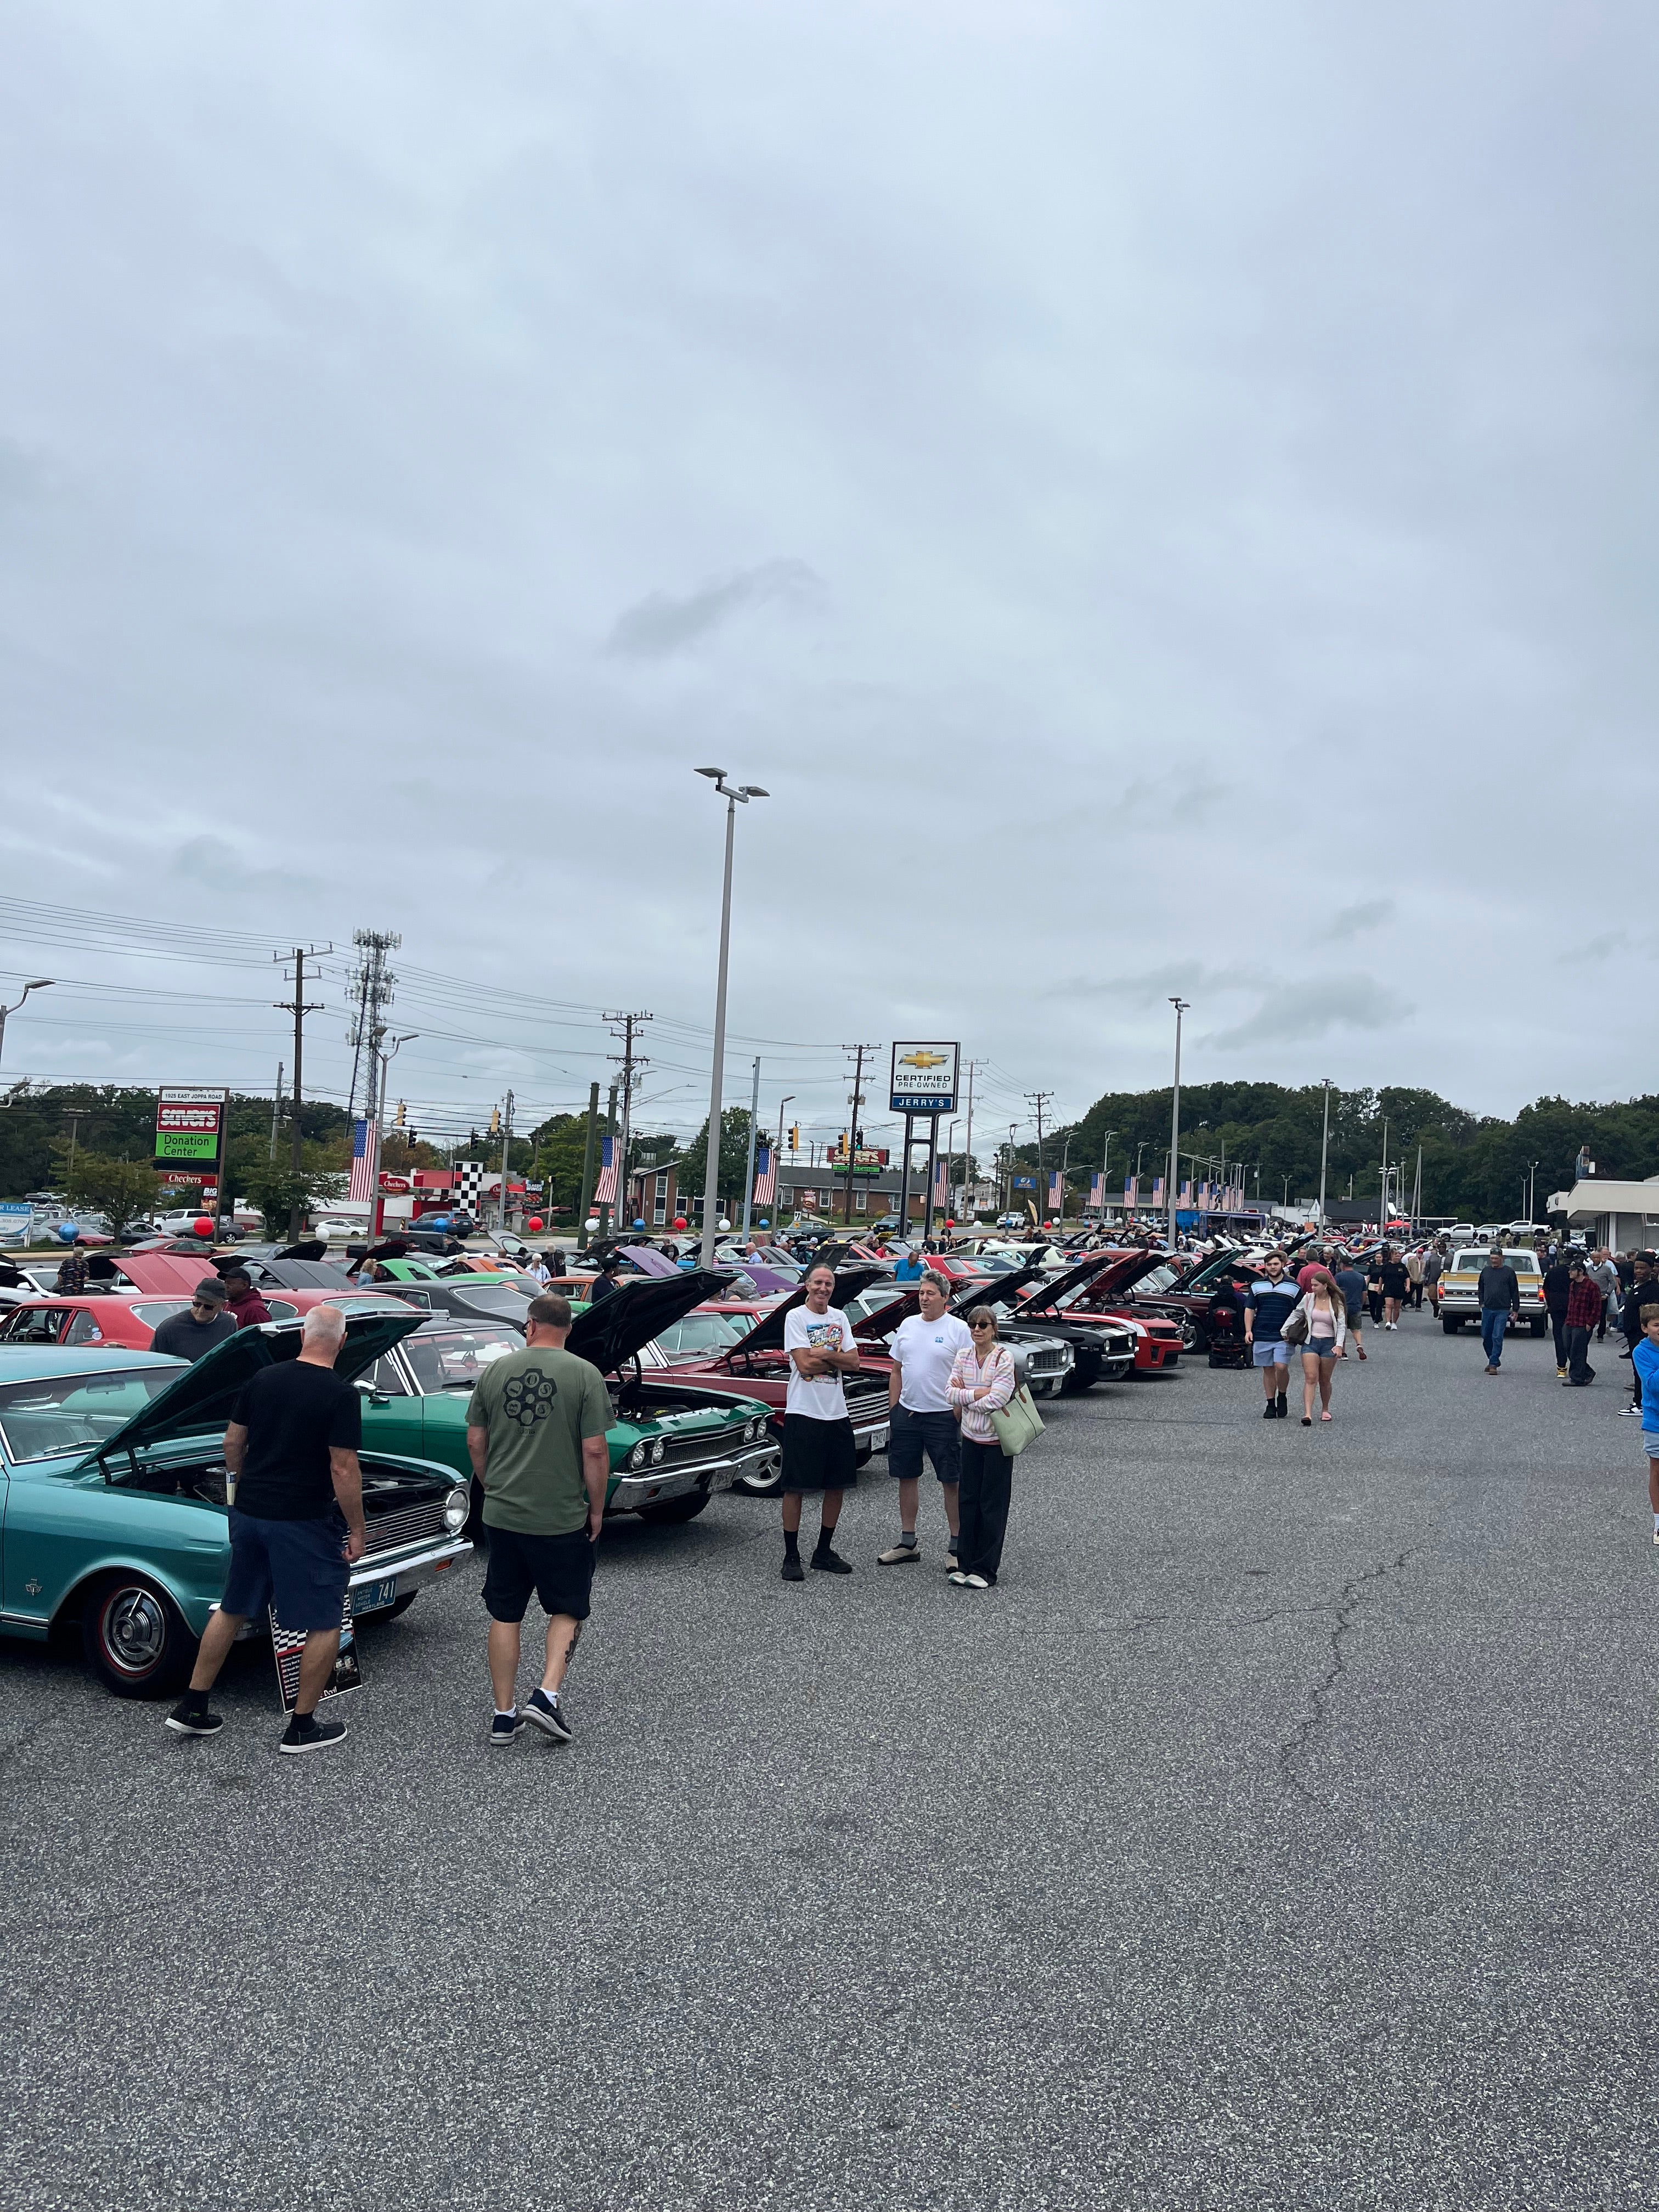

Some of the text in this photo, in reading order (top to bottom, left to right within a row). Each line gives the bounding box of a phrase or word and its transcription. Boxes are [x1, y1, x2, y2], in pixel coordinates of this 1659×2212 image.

[899, 1098, 944, 1107] JERRY'S
[165, 1135, 209, 1146] Donation
[164, 1146, 197, 1156] Center
[168, 1174, 202, 1183] Checkers
[379, 1581, 394, 1601] 741
[324, 1686, 337, 1696] Devil
